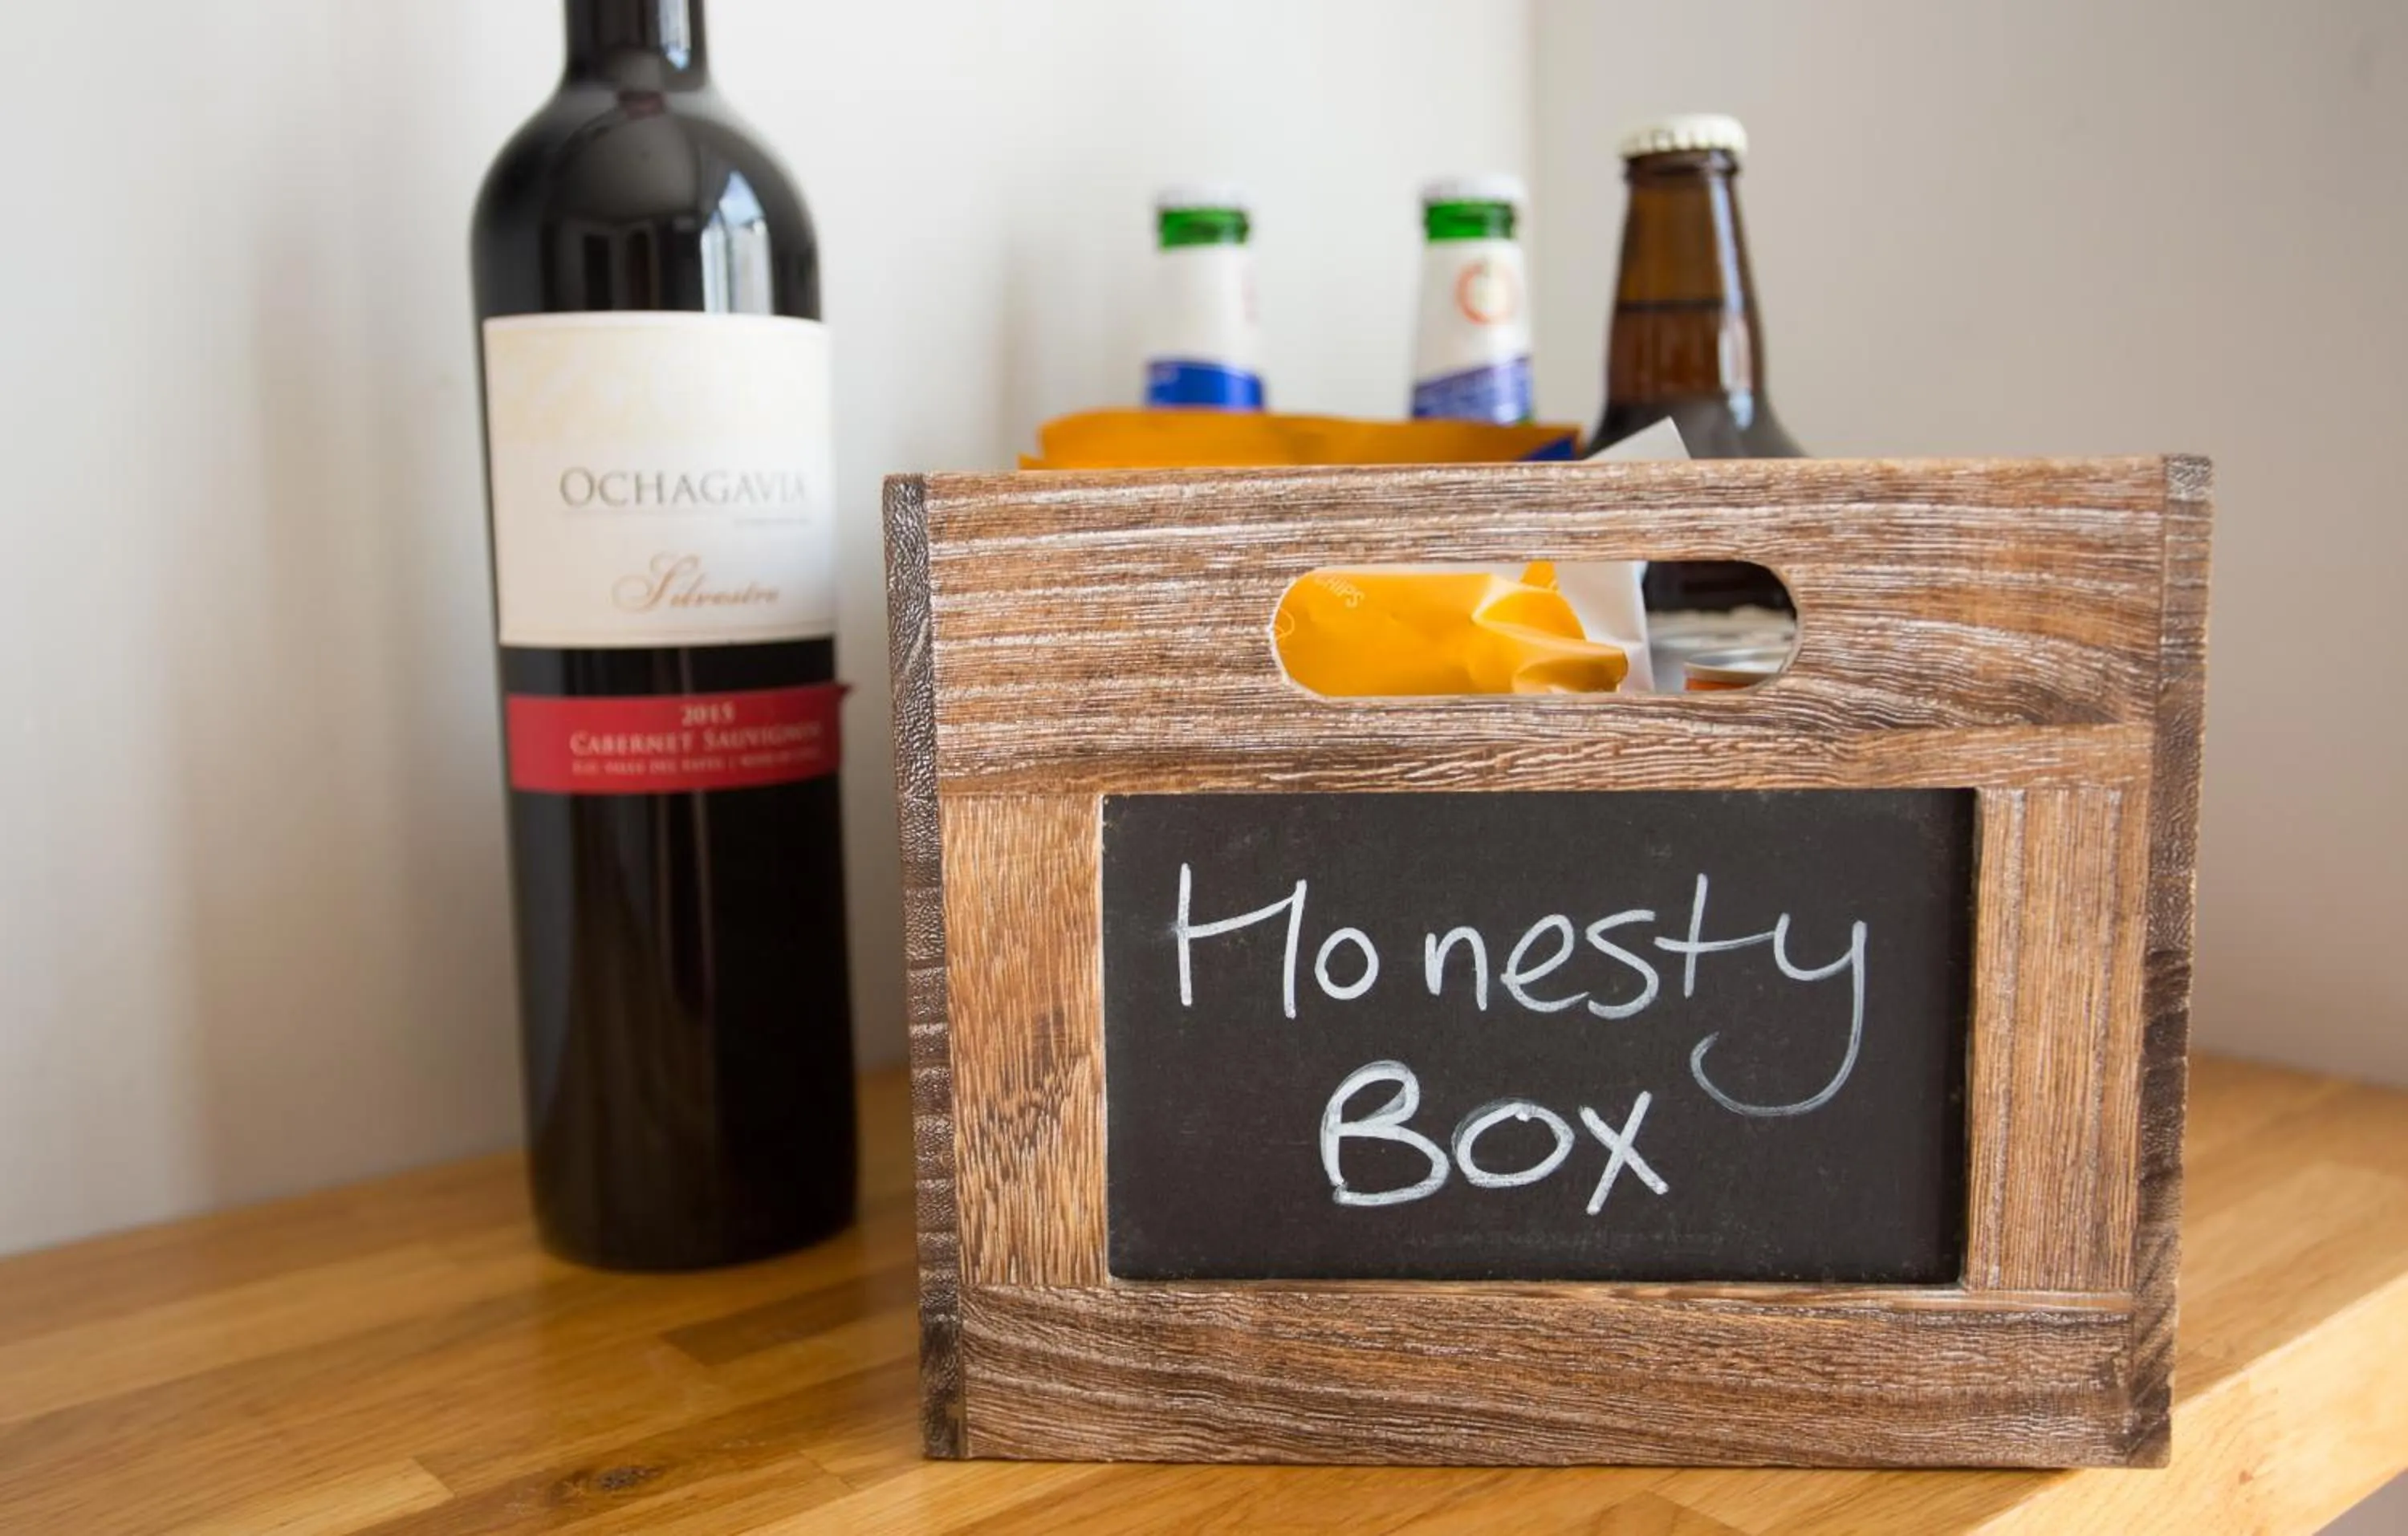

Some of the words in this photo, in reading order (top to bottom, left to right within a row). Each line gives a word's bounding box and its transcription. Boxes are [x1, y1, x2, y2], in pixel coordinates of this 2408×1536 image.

[681, 701, 735, 726] 2015
[570, 729, 694, 757] CABERNET
[1170, 862, 1867, 1117] Honesty
